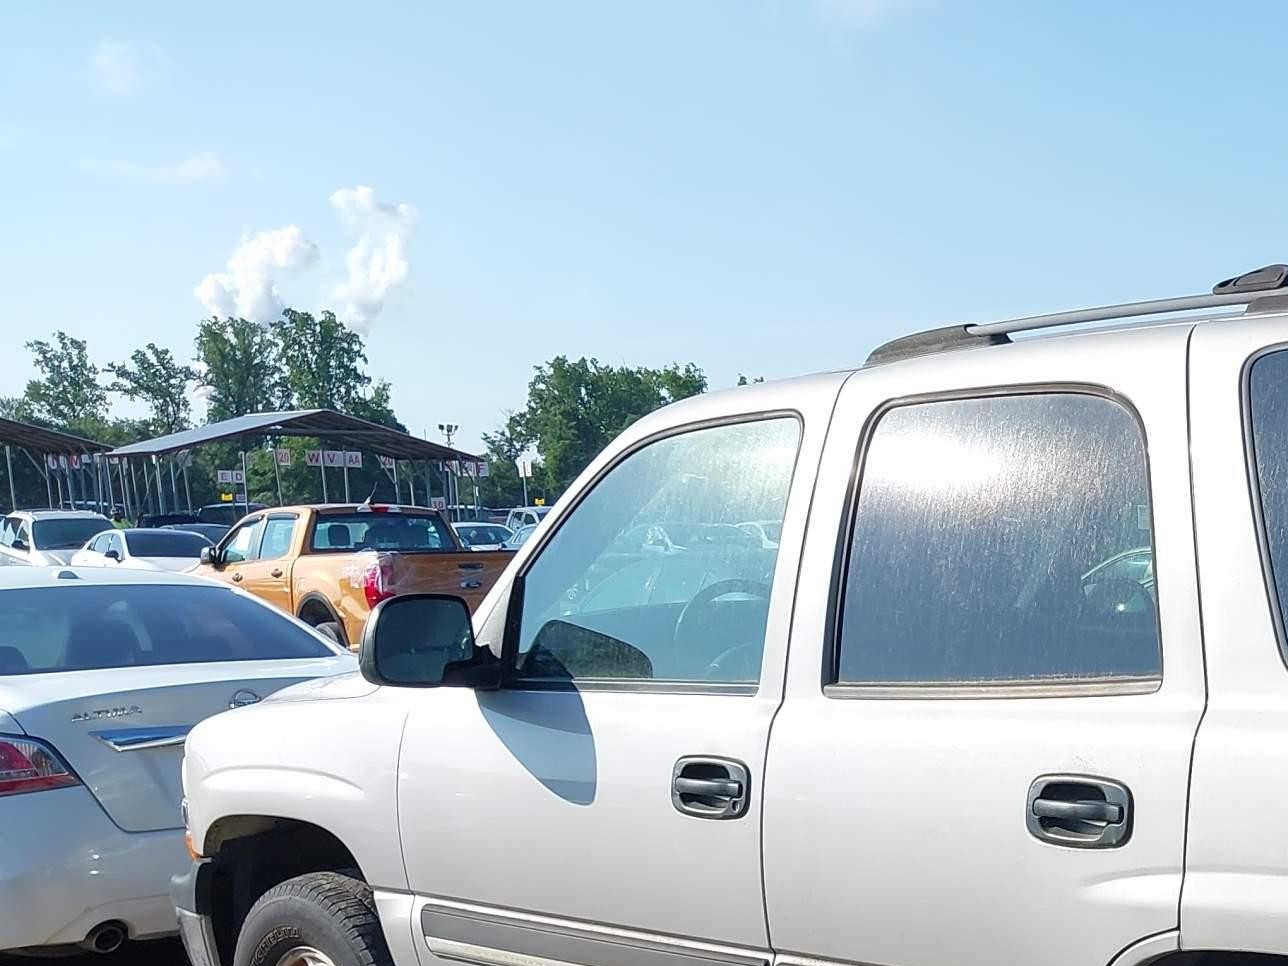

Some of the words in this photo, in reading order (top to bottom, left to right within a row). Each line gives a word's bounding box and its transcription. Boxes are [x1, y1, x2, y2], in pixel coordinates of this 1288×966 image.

[279, 452, 289, 463] 20
[307, 453, 320, 464] W
[327, 453, 337, 464] V
[349, 455, 361, 465] AA
[236, 472, 243, 481] D
